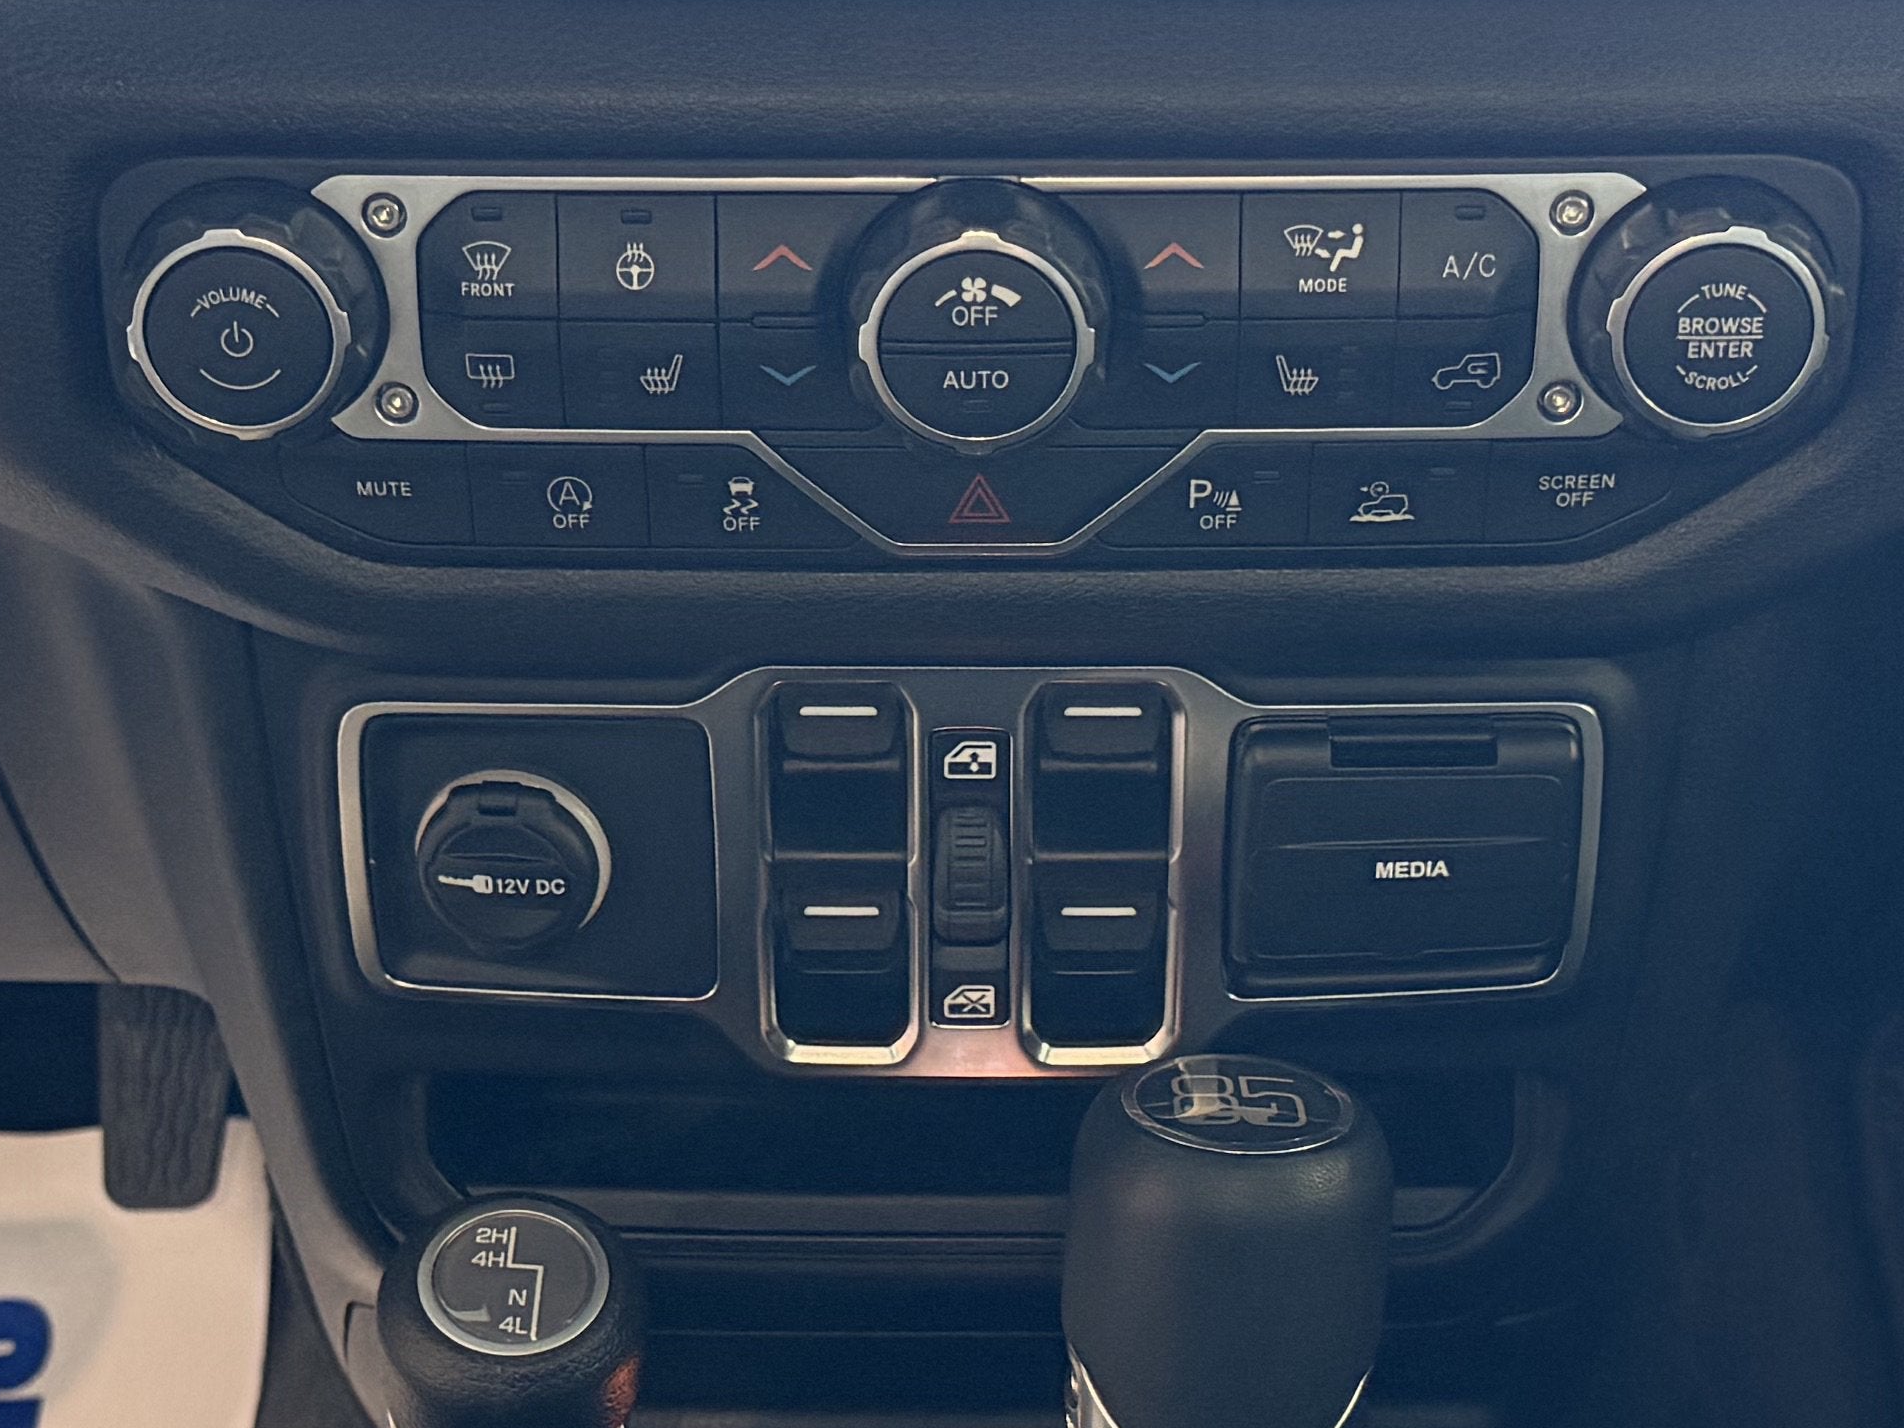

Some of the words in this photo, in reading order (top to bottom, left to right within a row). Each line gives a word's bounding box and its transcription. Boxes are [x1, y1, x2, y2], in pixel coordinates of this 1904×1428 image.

[1442, 253, 1497, 279] A/C
[461, 281, 515, 298] FRONT
[1298, 277, 1348, 293] MODE
[1700, 283, 1749, 301] TUNE
[197, 288, 268, 312] VOLUME
[951, 306, 999, 327] OFF
[1678, 315, 1764, 336] BROWSE
[1686, 339, 1755, 360] ENTER
[942, 370, 1010, 390] AUTO
[1684, 369, 1750, 392] SCROLL
[356, 481, 413, 498] MUTE
[1538, 474, 1617, 493] SCREEN
[1555, 490, 1595, 509] OFF
[552, 513, 591, 530] OFF
[722, 515, 761, 533] OFF
[1199, 514, 1238, 531] OFF
[1375, 860, 1450, 879] MEDIA
[496, 878, 530, 895] 12V
[535, 878, 567, 895] DC
[475, 1227, 508, 1244] 2H
[471, 1251, 507, 1268] 4H
[508, 1288, 528, 1306] N
[498, 1315, 529, 1335] 4L
